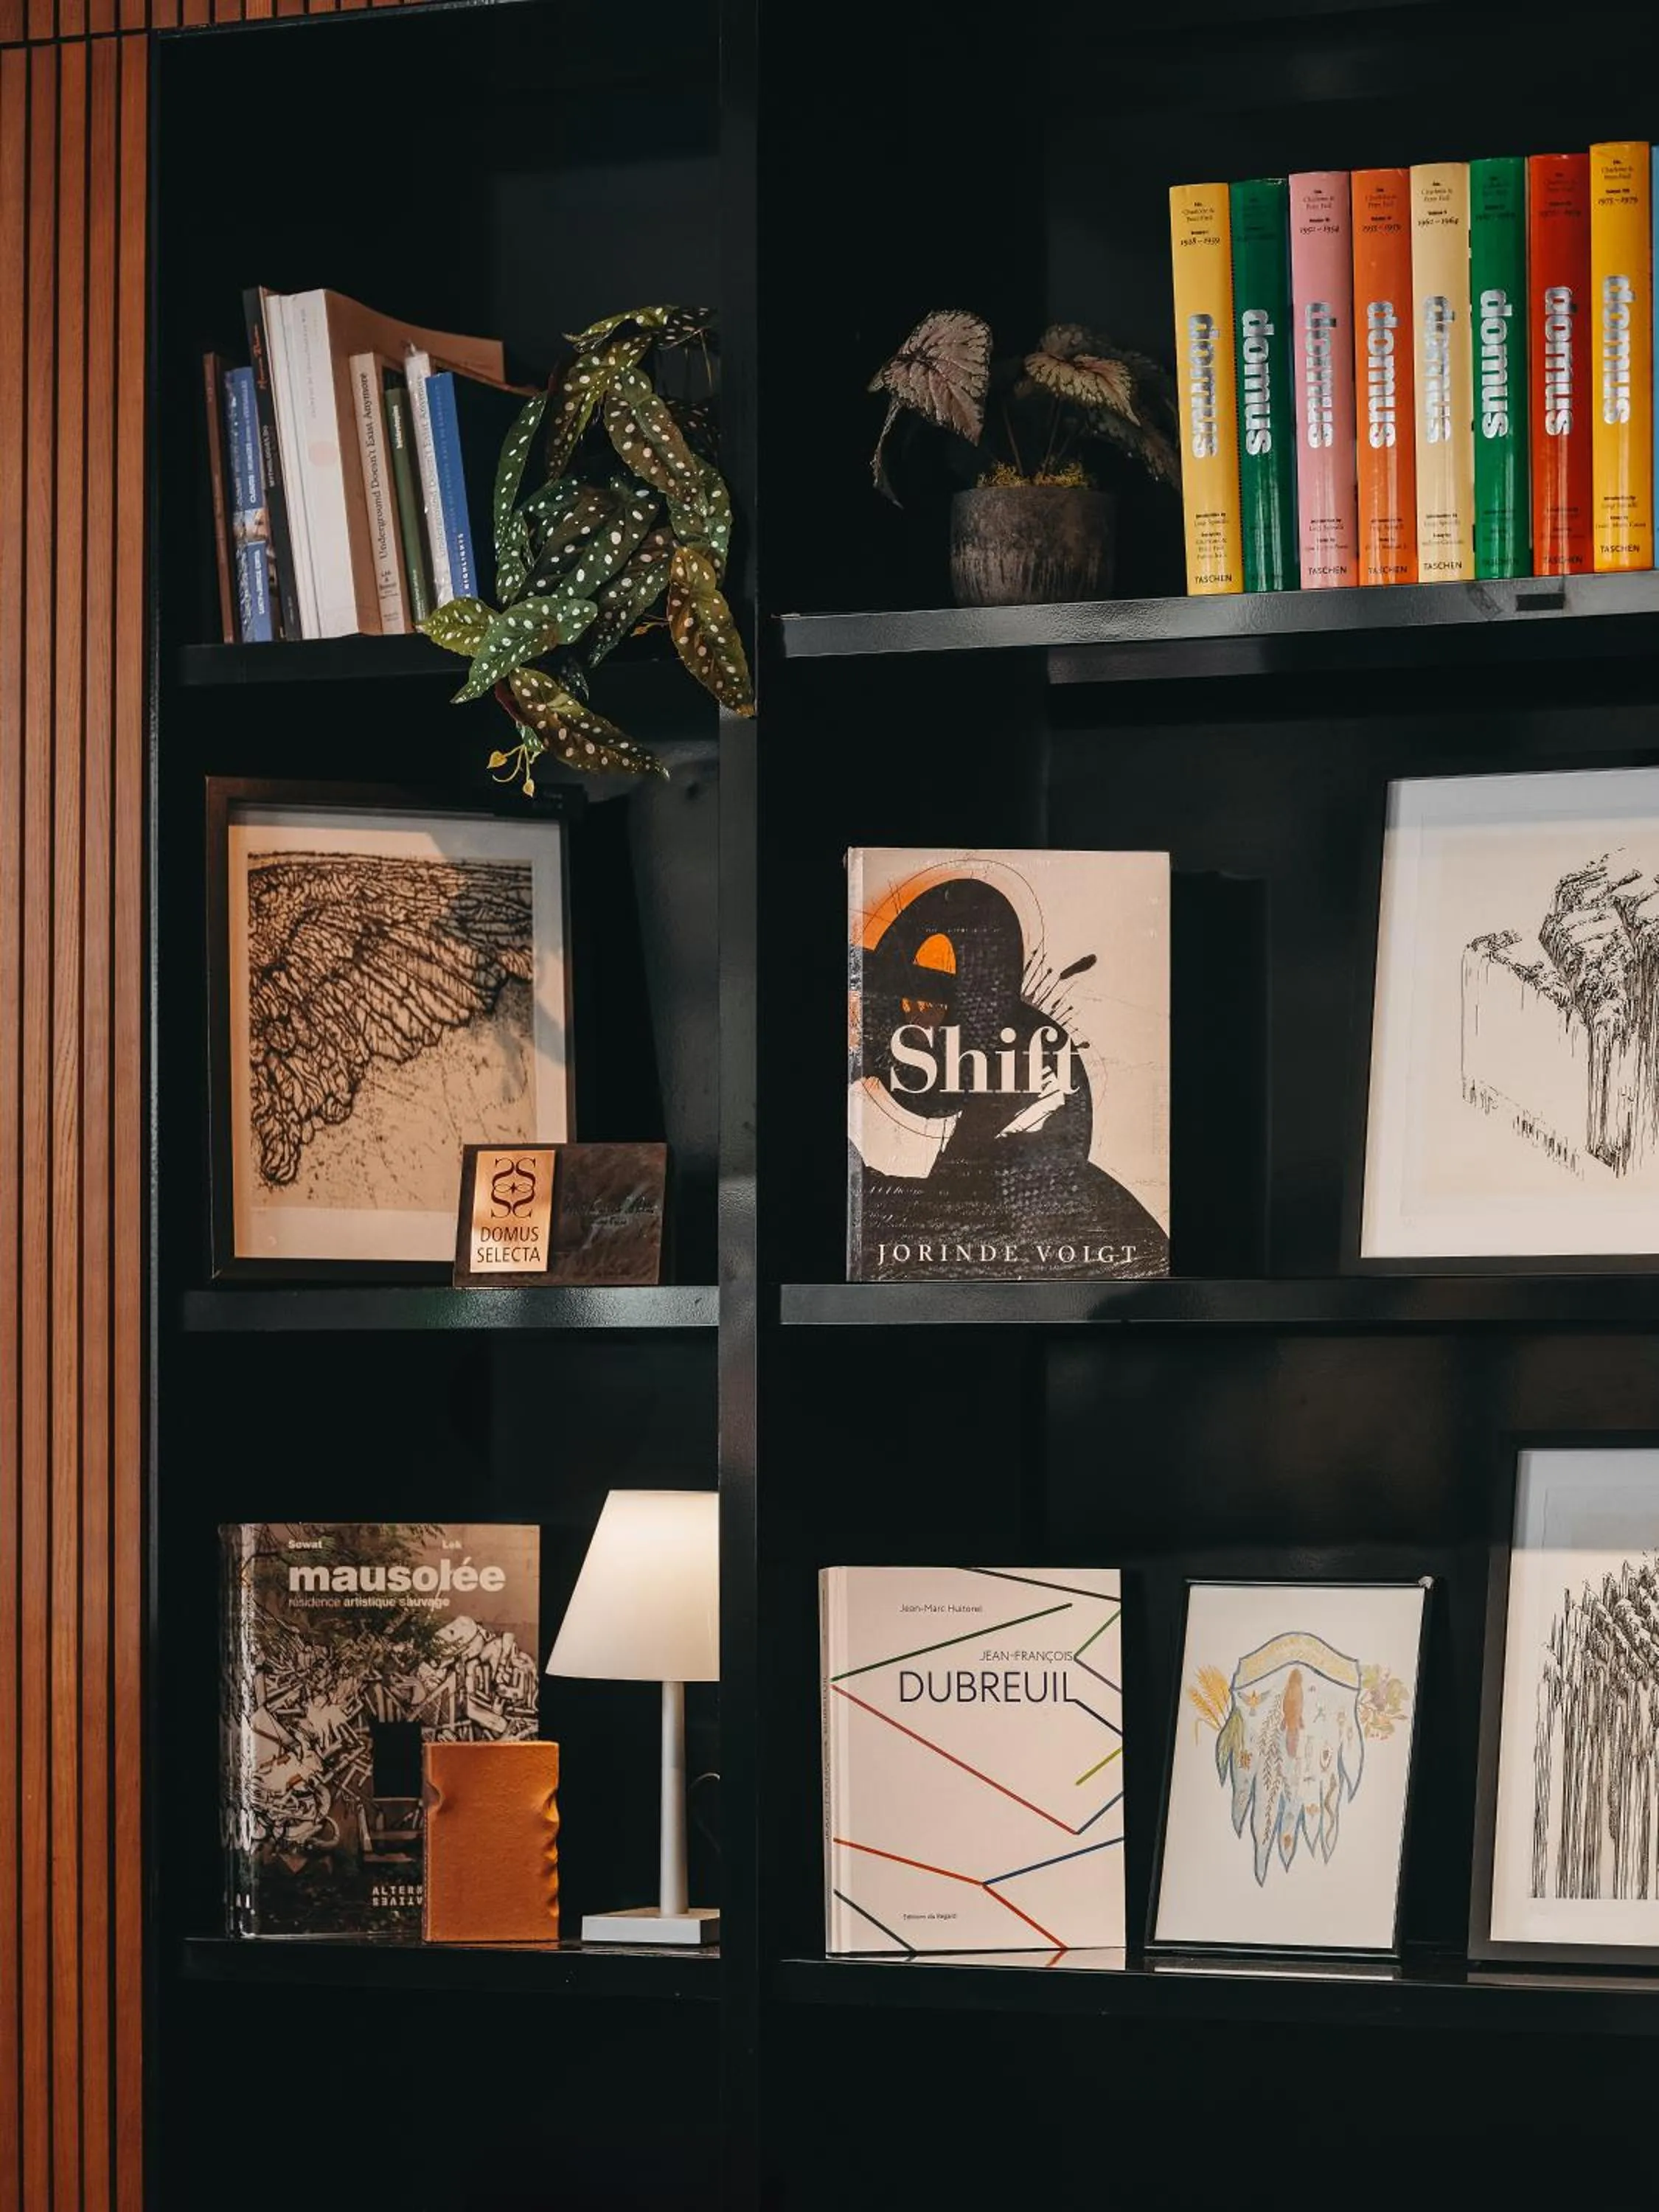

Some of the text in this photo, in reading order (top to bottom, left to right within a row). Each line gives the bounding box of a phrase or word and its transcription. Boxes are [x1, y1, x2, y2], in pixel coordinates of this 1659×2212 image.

[1545, 286, 1577, 436] domus
[1603, 275, 1636, 424] domus
[1305, 302, 1336, 448] domus
[1367, 302, 1399, 448] domus
[1424, 296, 1455, 443] domus
[1481, 290, 1512, 439] domus
[1189, 313, 1220, 458] domus
[1242, 310, 1274, 455] domus
[361, 372, 372, 420] Anymore
[366, 422, 375, 448] Exist
[372, 490, 387, 560] Underground
[1600, 543, 1641, 553] TASCHEN
[1307, 566, 1349, 575] TASCHEN
[1368, 566, 1408, 575] TASCHEN
[1423, 561, 1462, 570] TASCHEN
[1194, 574, 1232, 584] TASCHEN
[890, 1024, 1080, 1095] Shift
[480, 1226, 539, 1242] DOMUS
[477, 1246, 541, 1263] SELECTA
[878, 1244, 1136, 1265] JORINDE VOIGT
[288, 1540, 323, 1549] Sowat
[288, 1557, 506, 1592] mausolée
[344, 1596, 396, 1608] artistique
[400, 1596, 451, 1610] sauvage
[900, 1603, 945, 1613] Jean-Marc
[979, 1650, 1074, 1663] JEAN-FRANÇOIS
[899, 1671, 1077, 1703] DUBREUIL
[372, 1885, 423, 1896] ALTERN
